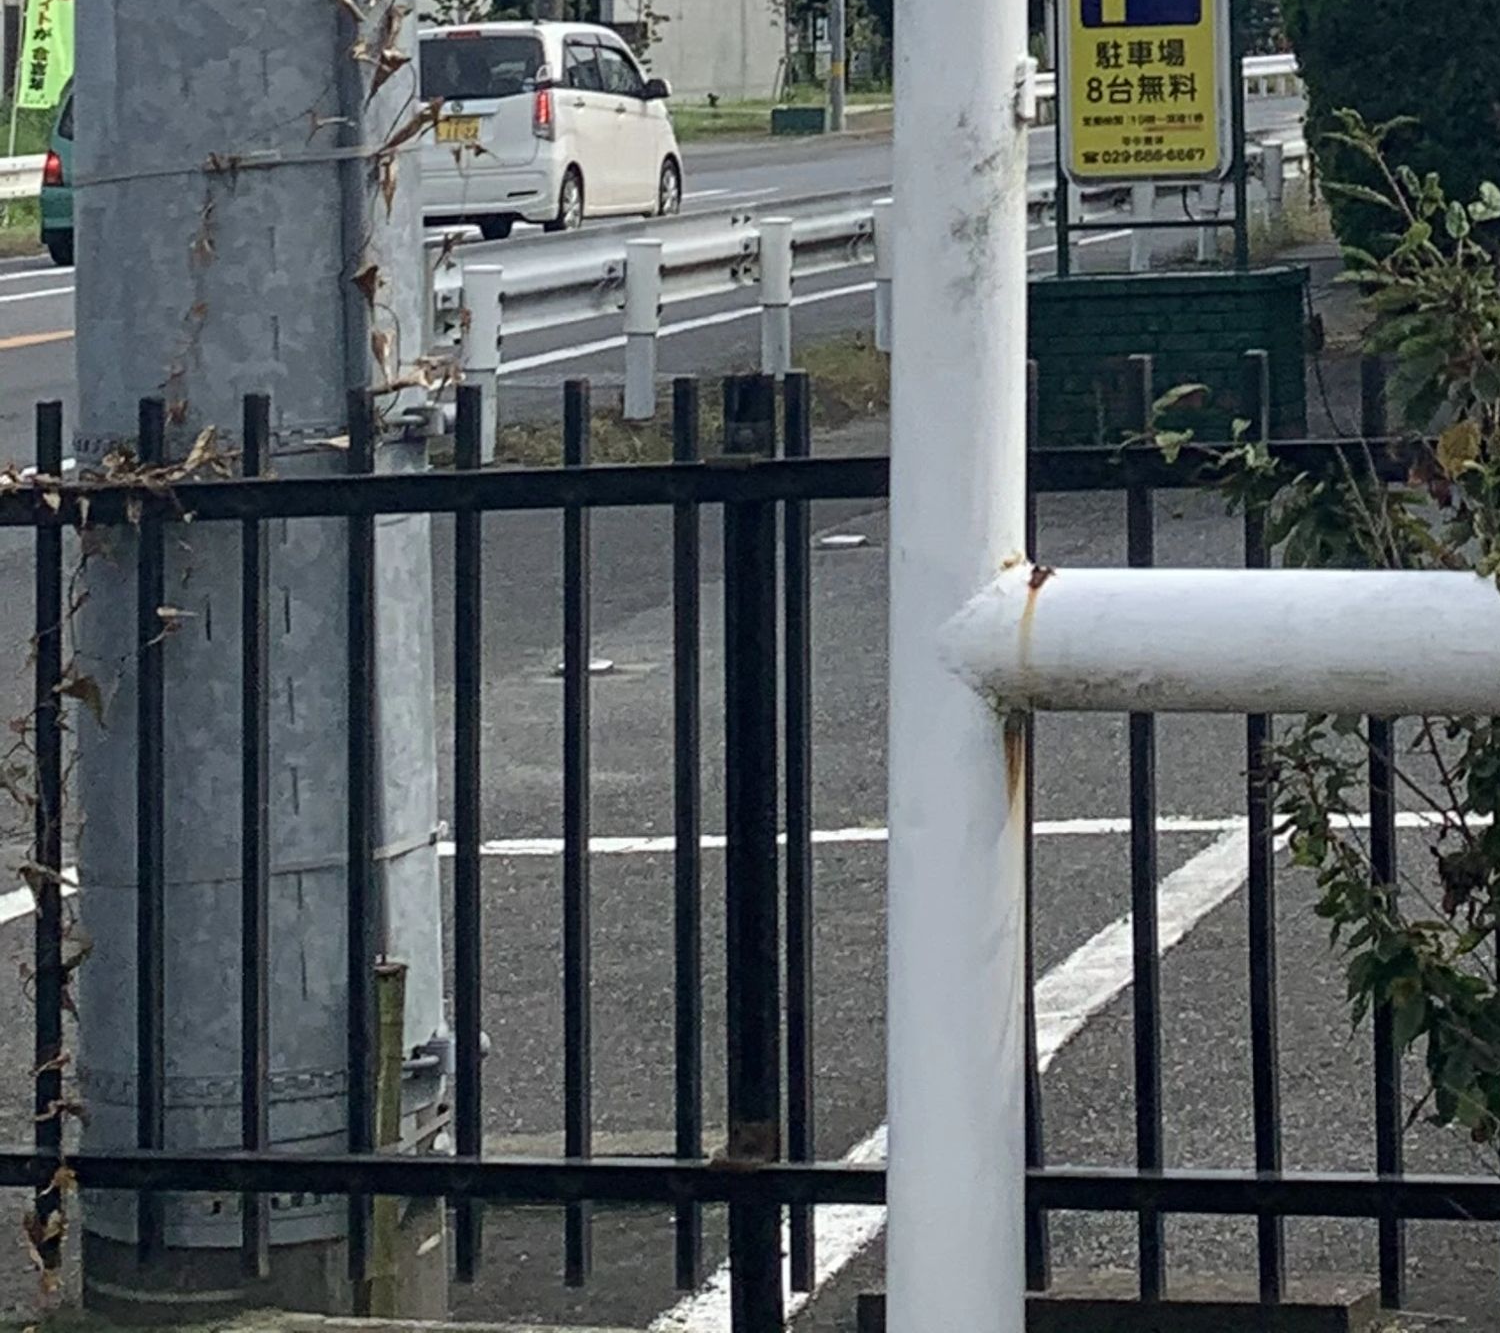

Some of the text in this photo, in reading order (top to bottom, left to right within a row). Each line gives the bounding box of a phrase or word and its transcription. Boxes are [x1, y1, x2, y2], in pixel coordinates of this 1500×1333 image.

[1096, 39, 1186, 69] 駐車場
[1086, 73, 1197, 105] 8台無料
